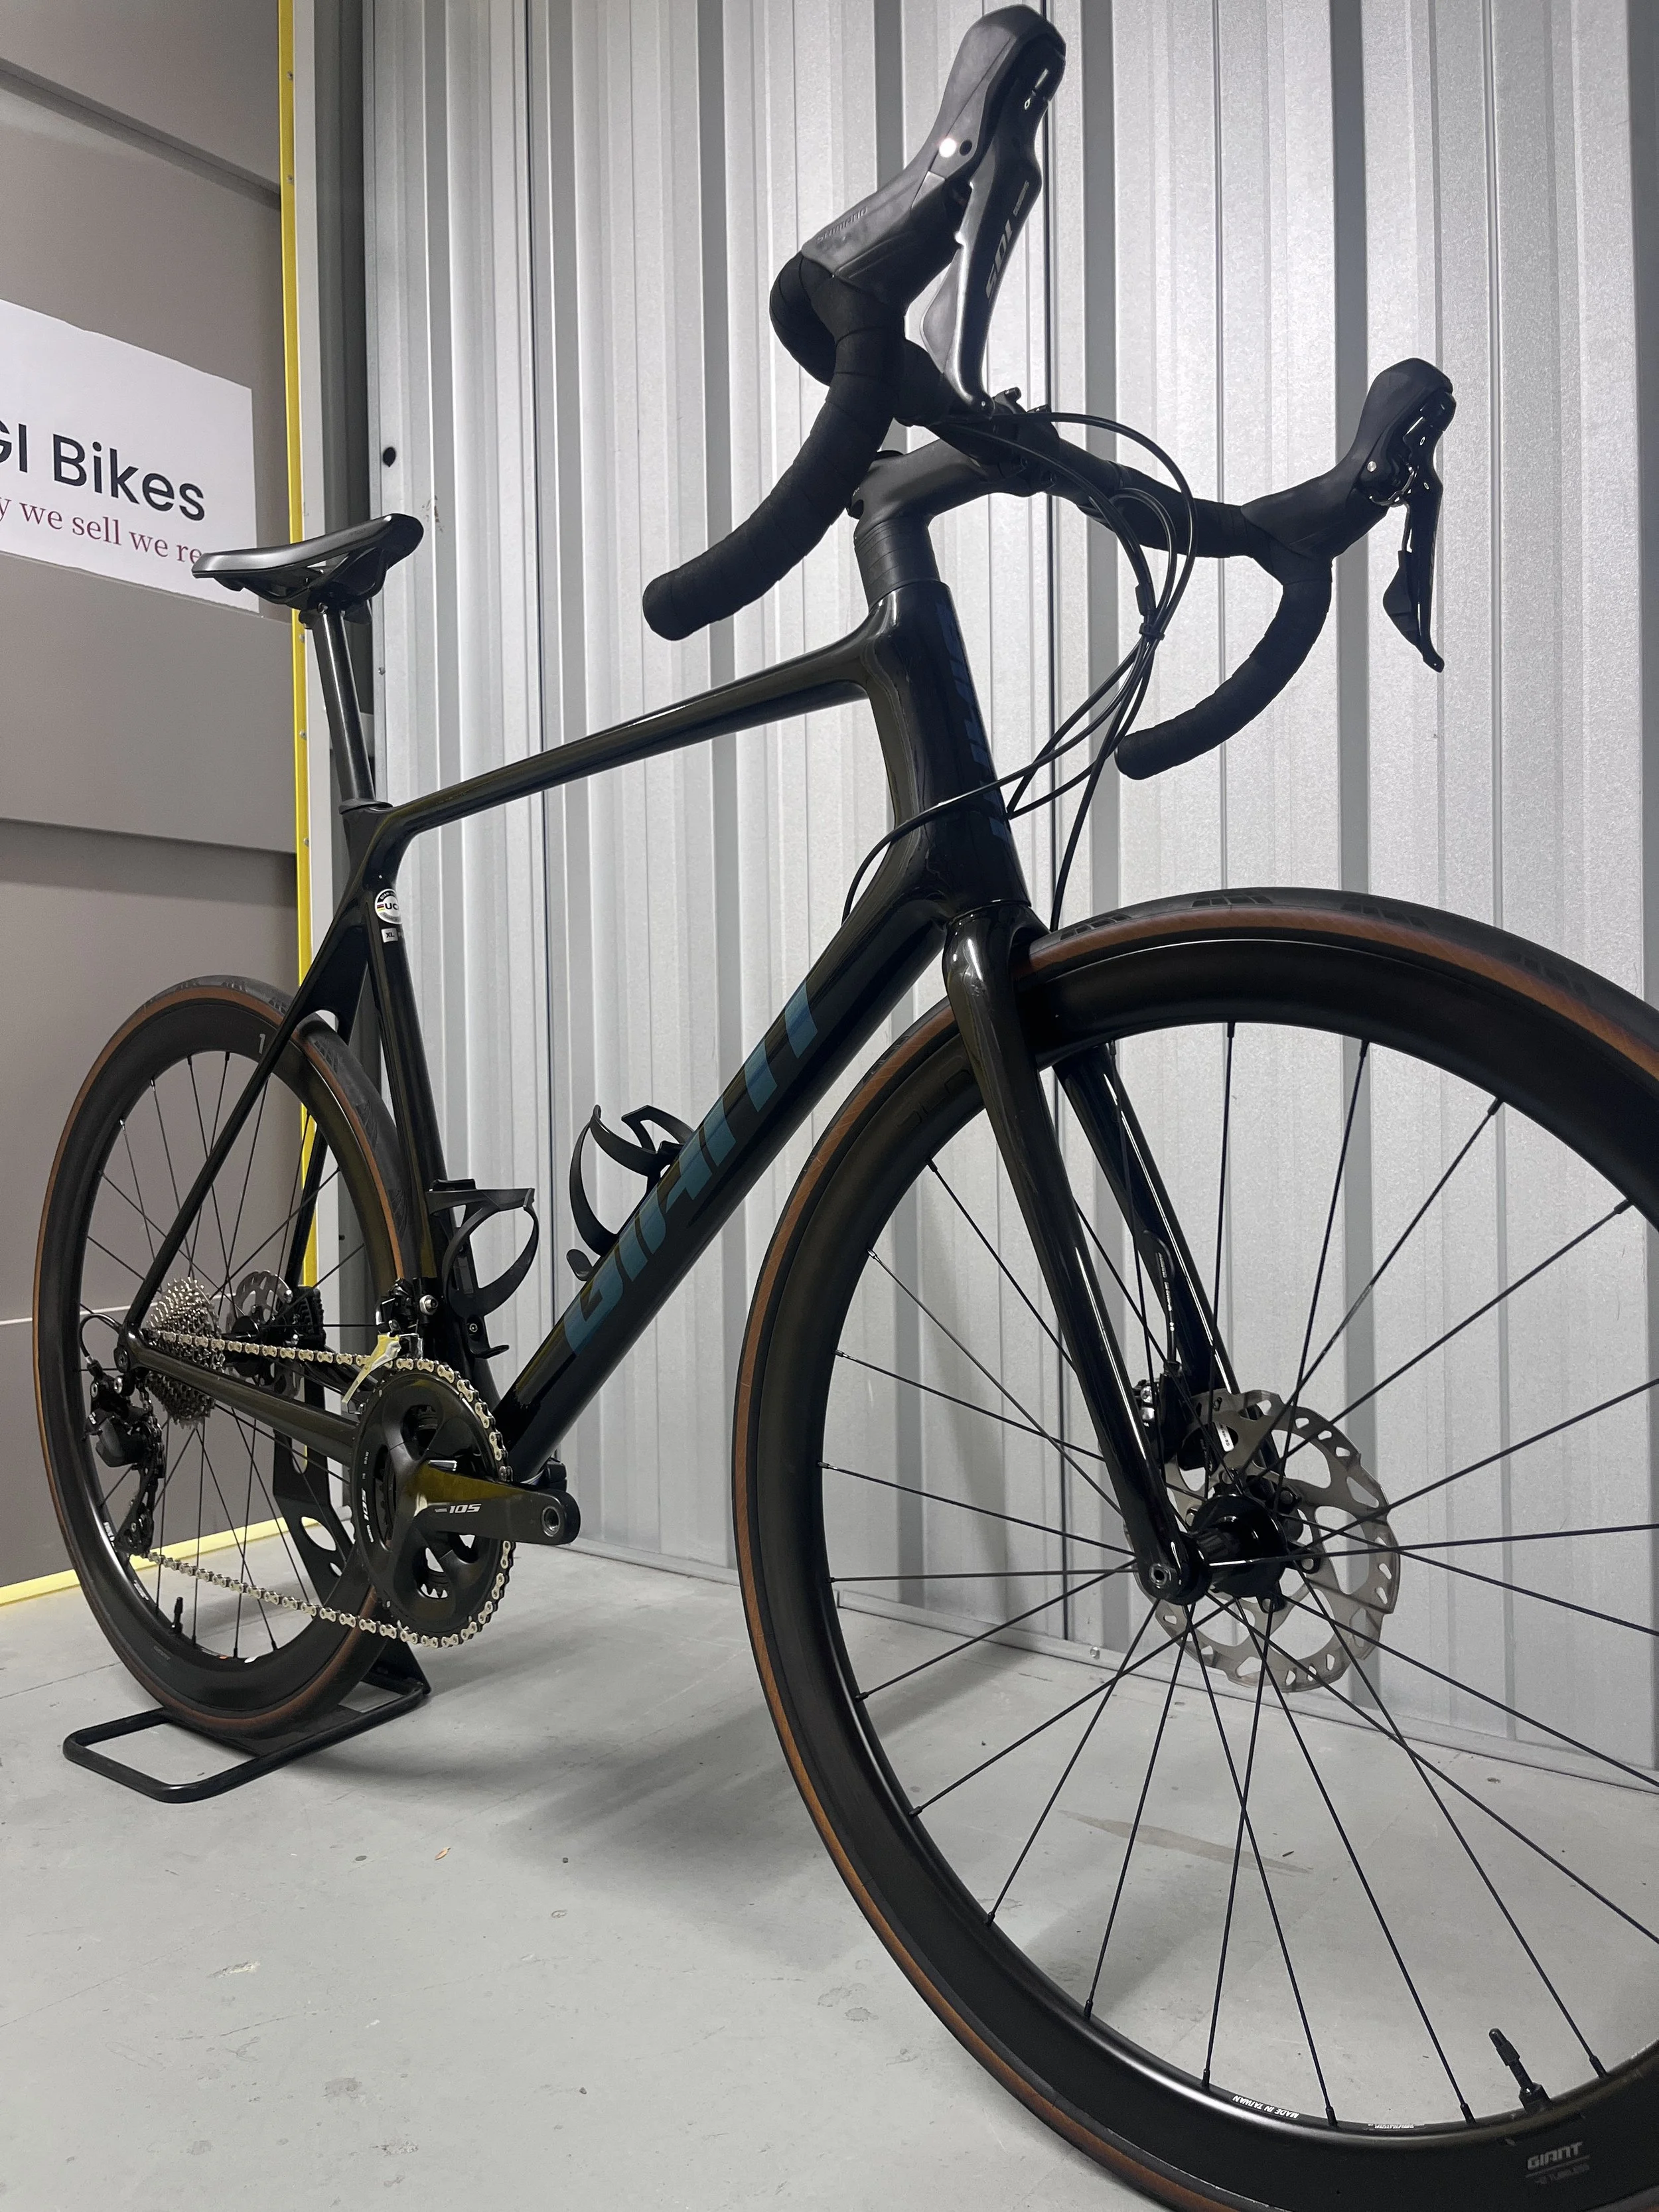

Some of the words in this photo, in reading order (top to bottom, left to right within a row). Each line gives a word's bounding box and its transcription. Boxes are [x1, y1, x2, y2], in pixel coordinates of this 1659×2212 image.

[53, 433, 205, 522] Bikes
[19, 502, 63, 530] we
[72, 516, 122, 546] sell
[129, 531, 169, 557] we
[449, 1503, 482, 1514] 105
[1232, 2095, 1264, 2110] TAIWAN
[1274, 2108, 1300, 2118] MADE
[1527, 2141, 1583, 2170] GIANT
